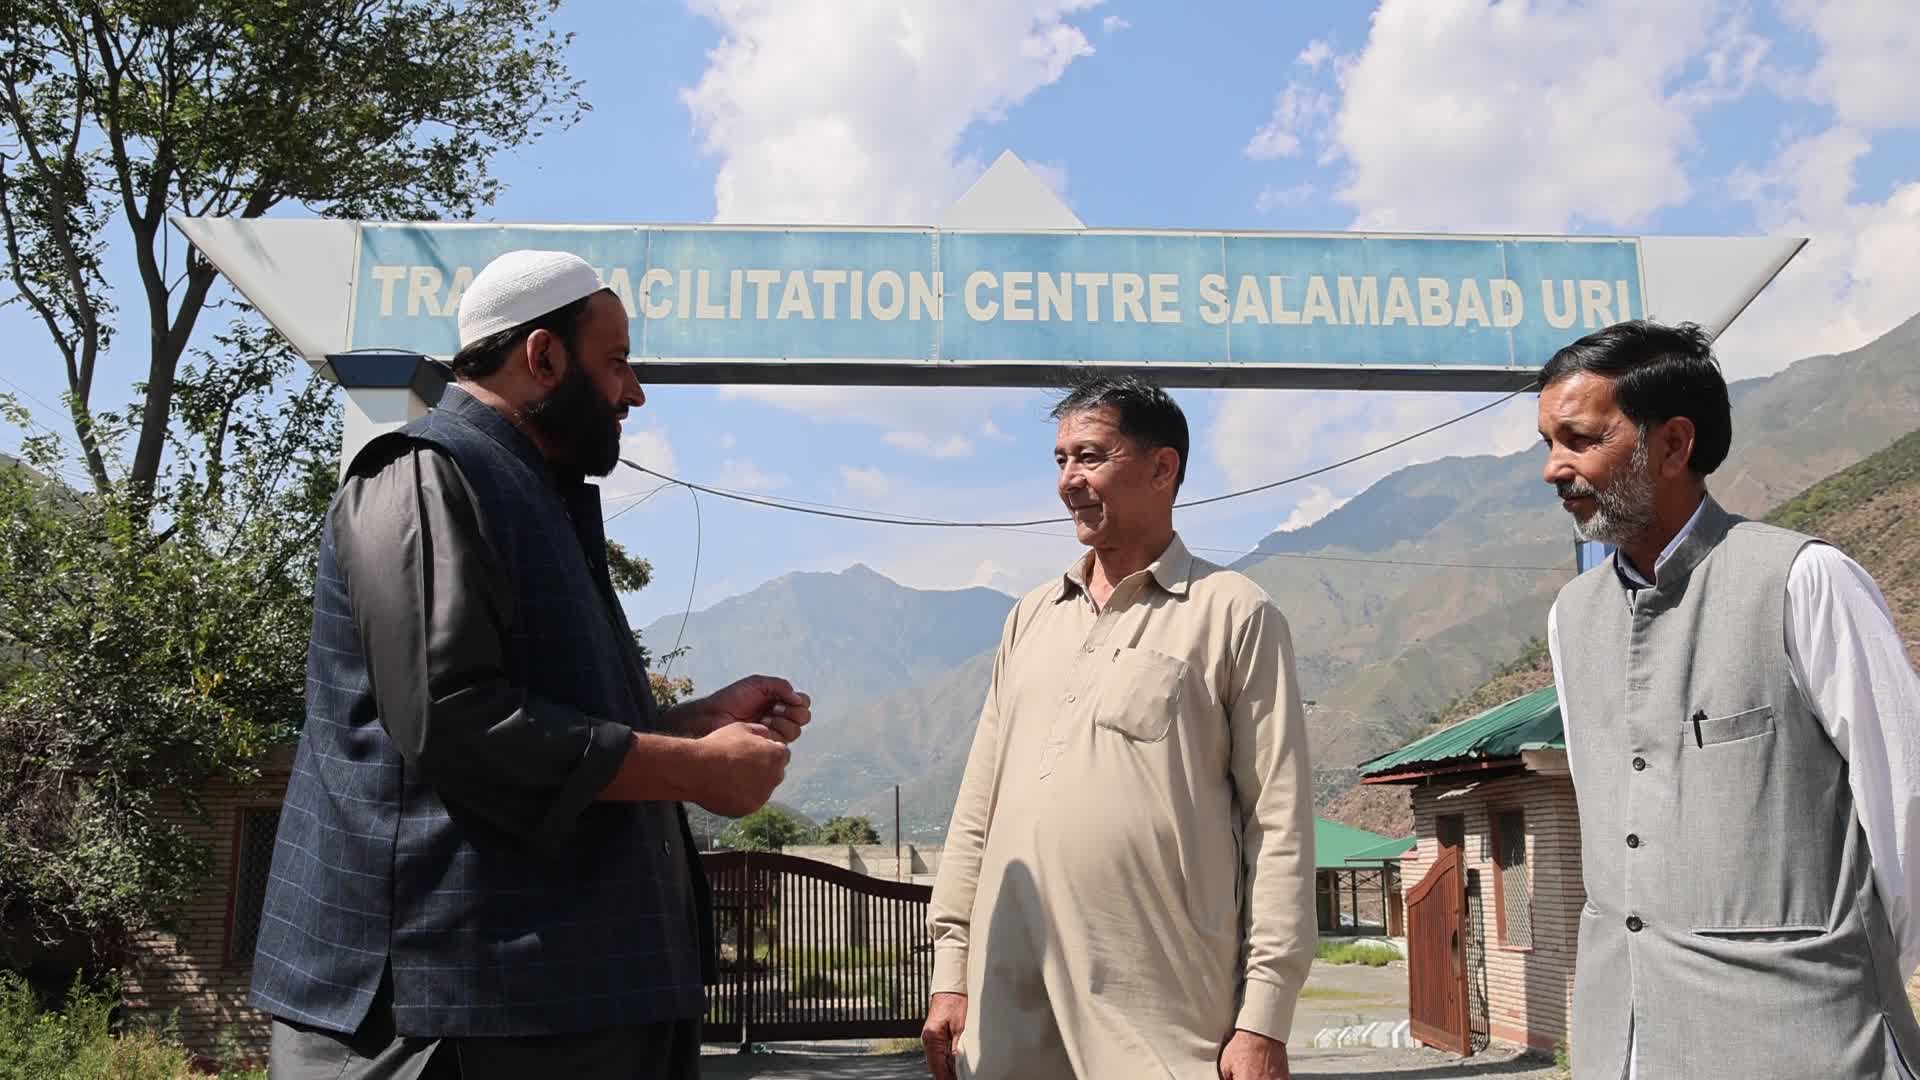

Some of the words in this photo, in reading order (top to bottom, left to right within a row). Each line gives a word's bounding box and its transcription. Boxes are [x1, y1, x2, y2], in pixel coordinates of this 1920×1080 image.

[592, 267, 944, 321] ACILITATION
[964, 271, 1181, 323] CENTRE
[1199, 273, 1524, 328] SALAMABAD
[1541, 279, 1633, 329] URI
